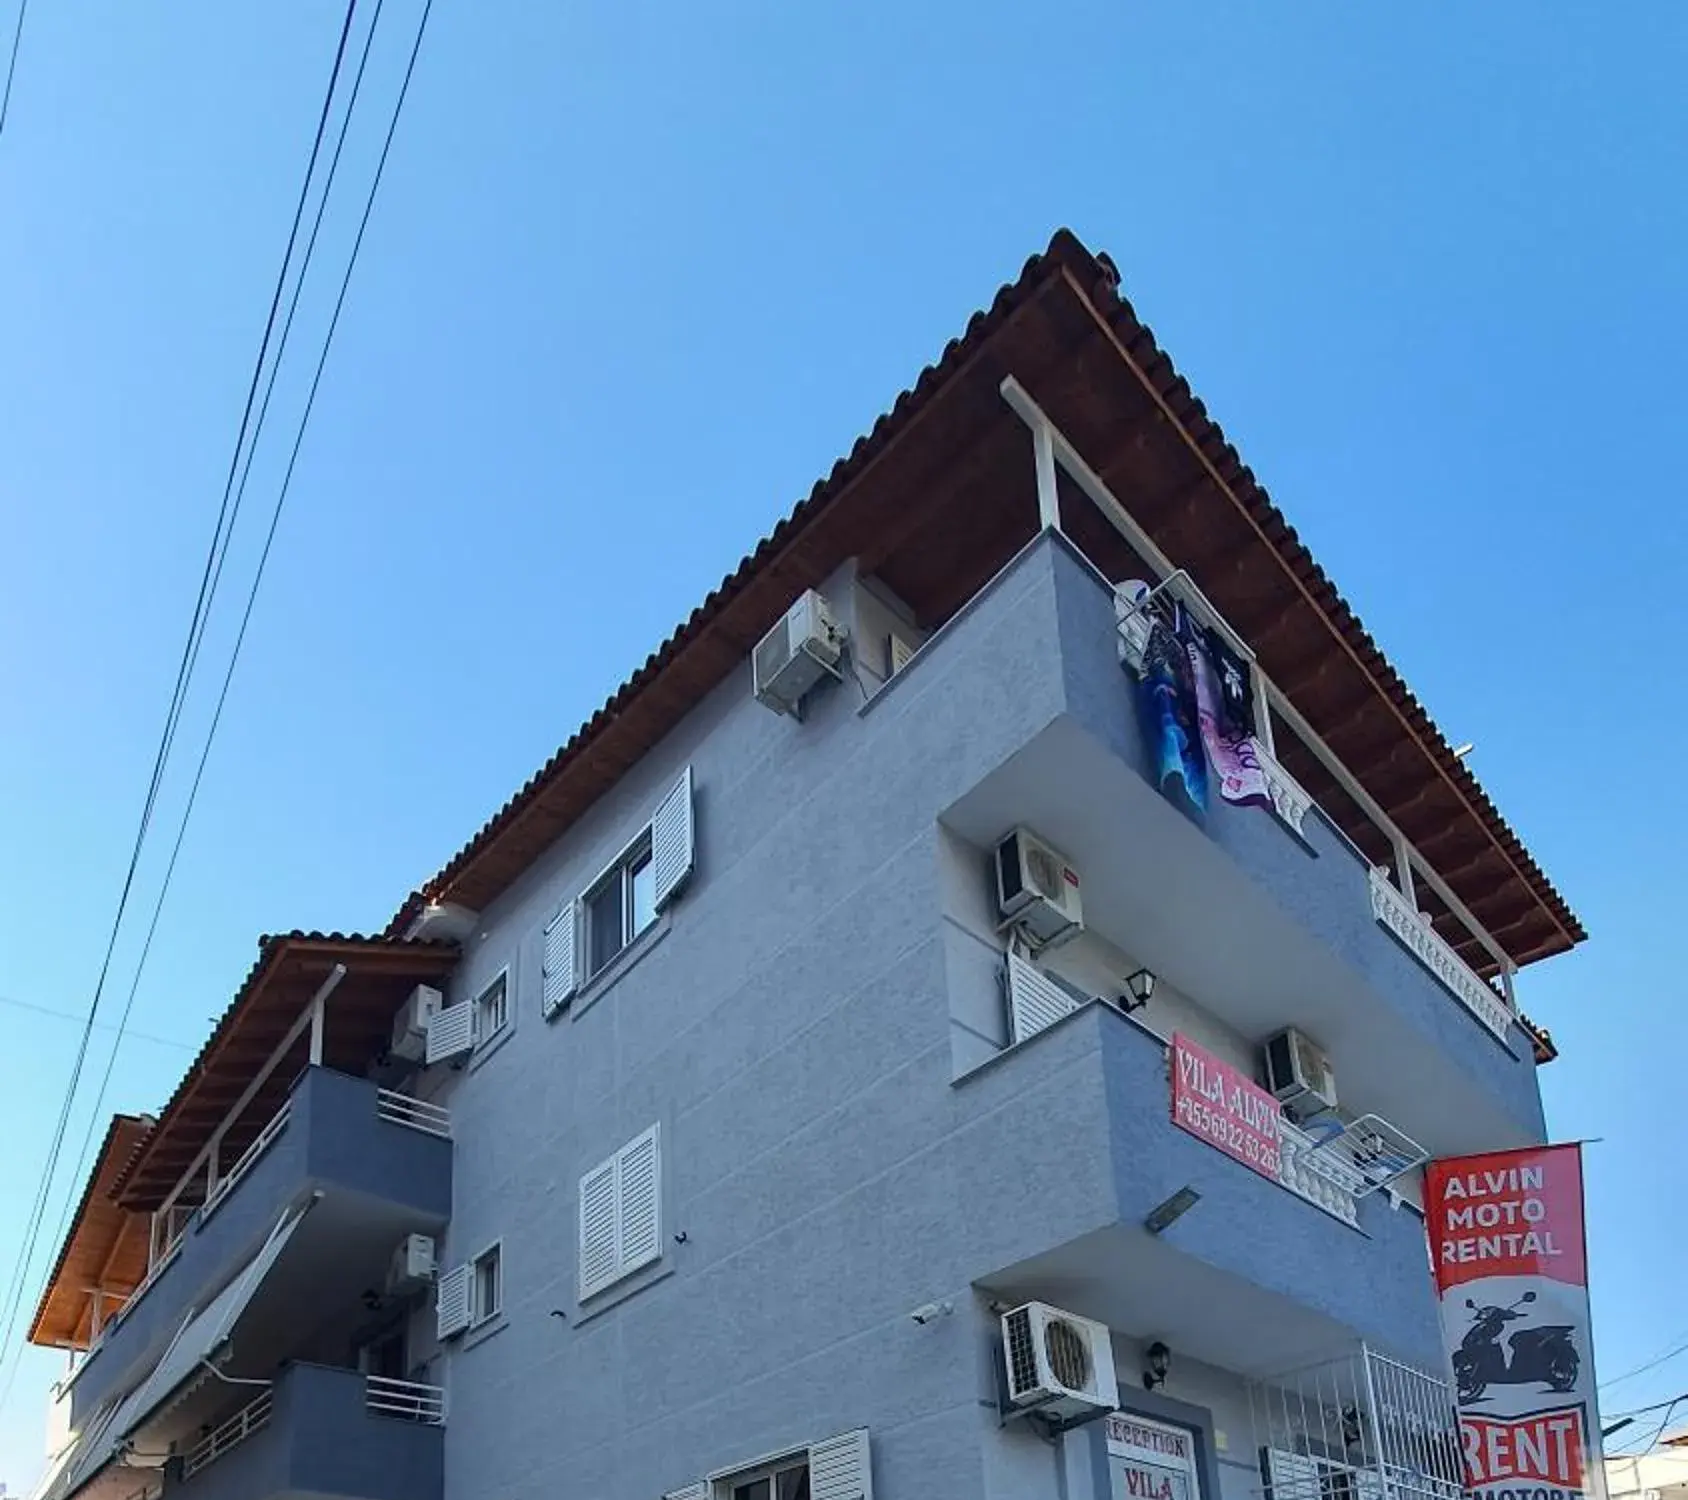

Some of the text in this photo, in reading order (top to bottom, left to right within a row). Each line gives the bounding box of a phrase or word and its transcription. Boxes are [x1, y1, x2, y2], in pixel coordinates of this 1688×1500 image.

[1176, 1046, 1225, 1108] VILA
[1443, 1167, 1543, 1200] ALVIN
[1447, 1199, 1545, 1231] MOTO
[1442, 1231, 1563, 1264] RENTAL
[1461, 1419, 1573, 1481] RENT
